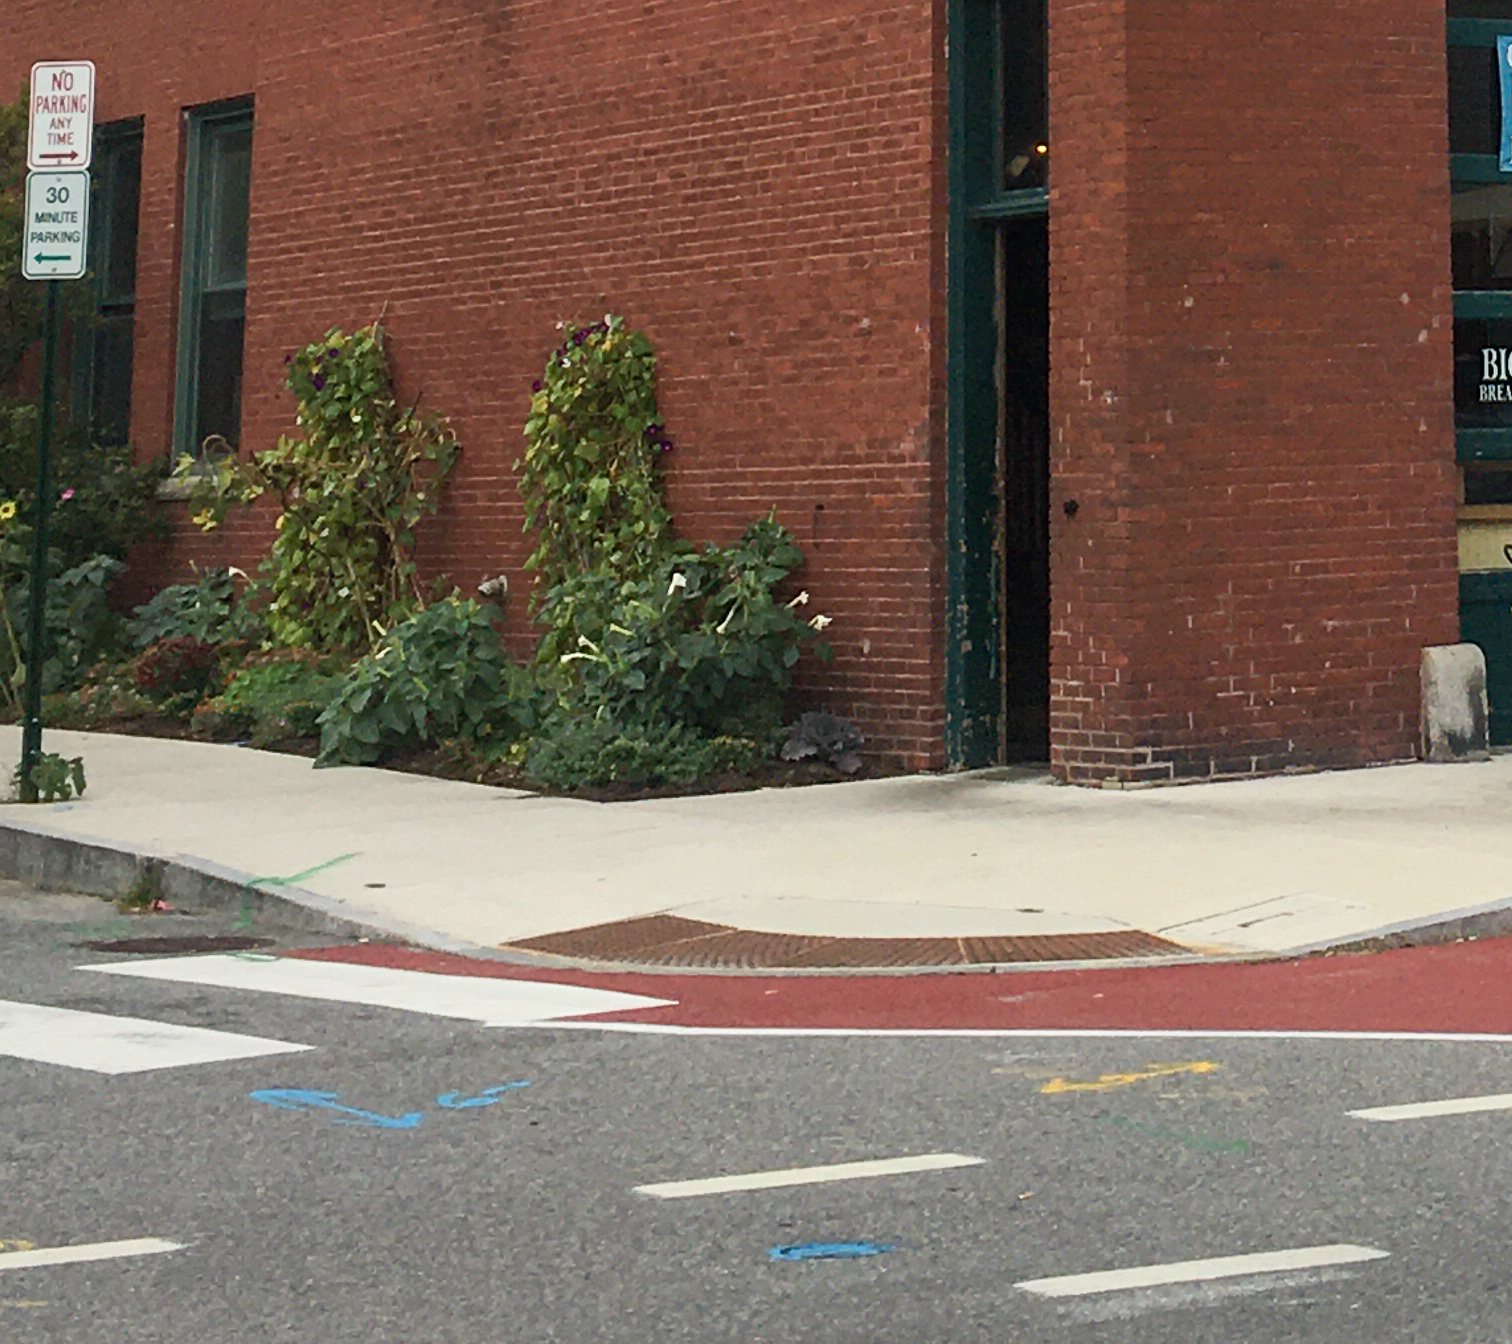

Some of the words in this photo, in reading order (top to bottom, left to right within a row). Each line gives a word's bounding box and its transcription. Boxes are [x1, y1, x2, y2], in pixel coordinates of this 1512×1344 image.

[52, 71, 74, 92] NO
[35, 94, 87, 114] PARKING
[49, 117, 73, 130] ANY
[47, 132, 74, 146] TIME
[46, 187, 70, 204] 30
[34, 211, 78, 224] MINUTE
[30, 231, 81, 244] PARKING
